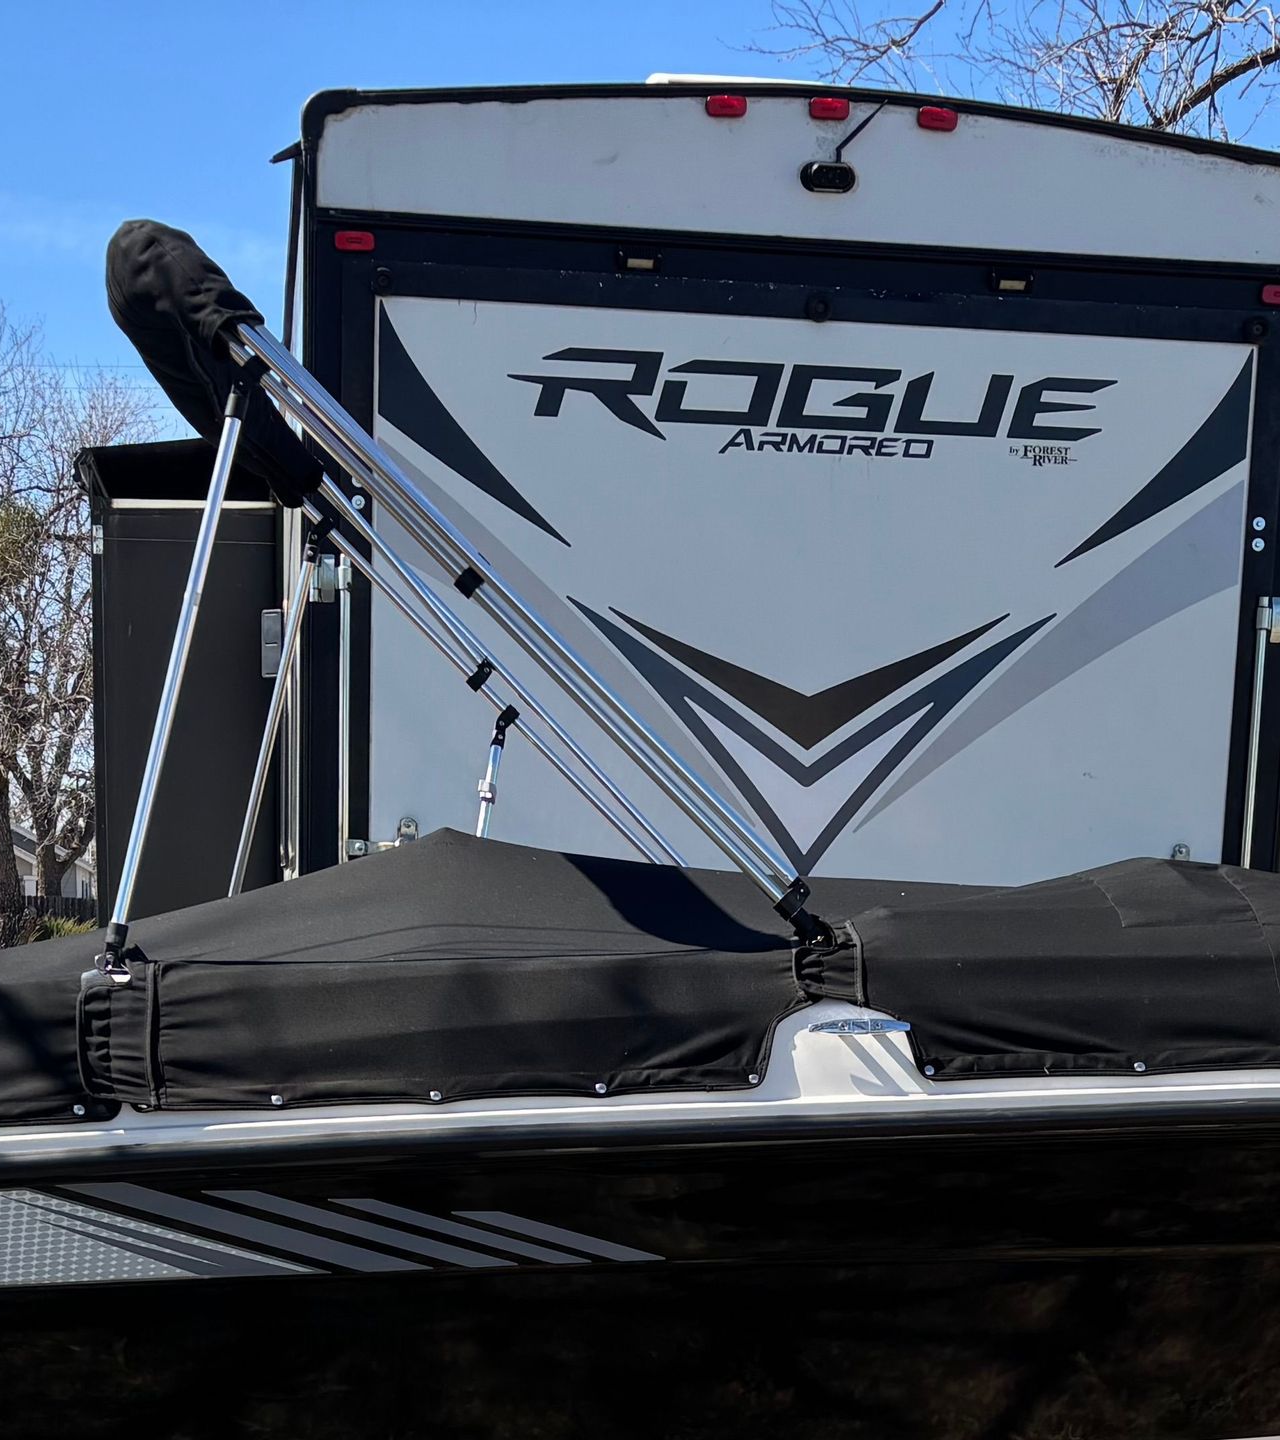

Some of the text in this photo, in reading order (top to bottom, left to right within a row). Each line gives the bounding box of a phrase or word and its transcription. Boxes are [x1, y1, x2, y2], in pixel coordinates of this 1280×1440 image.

[506, 347, 1119, 441] ROGUE
[718, 427, 935, 459] ARMORED
[1009, 445, 1071, 457] by FOREST
[1032, 454, 1069, 467] RIVER
